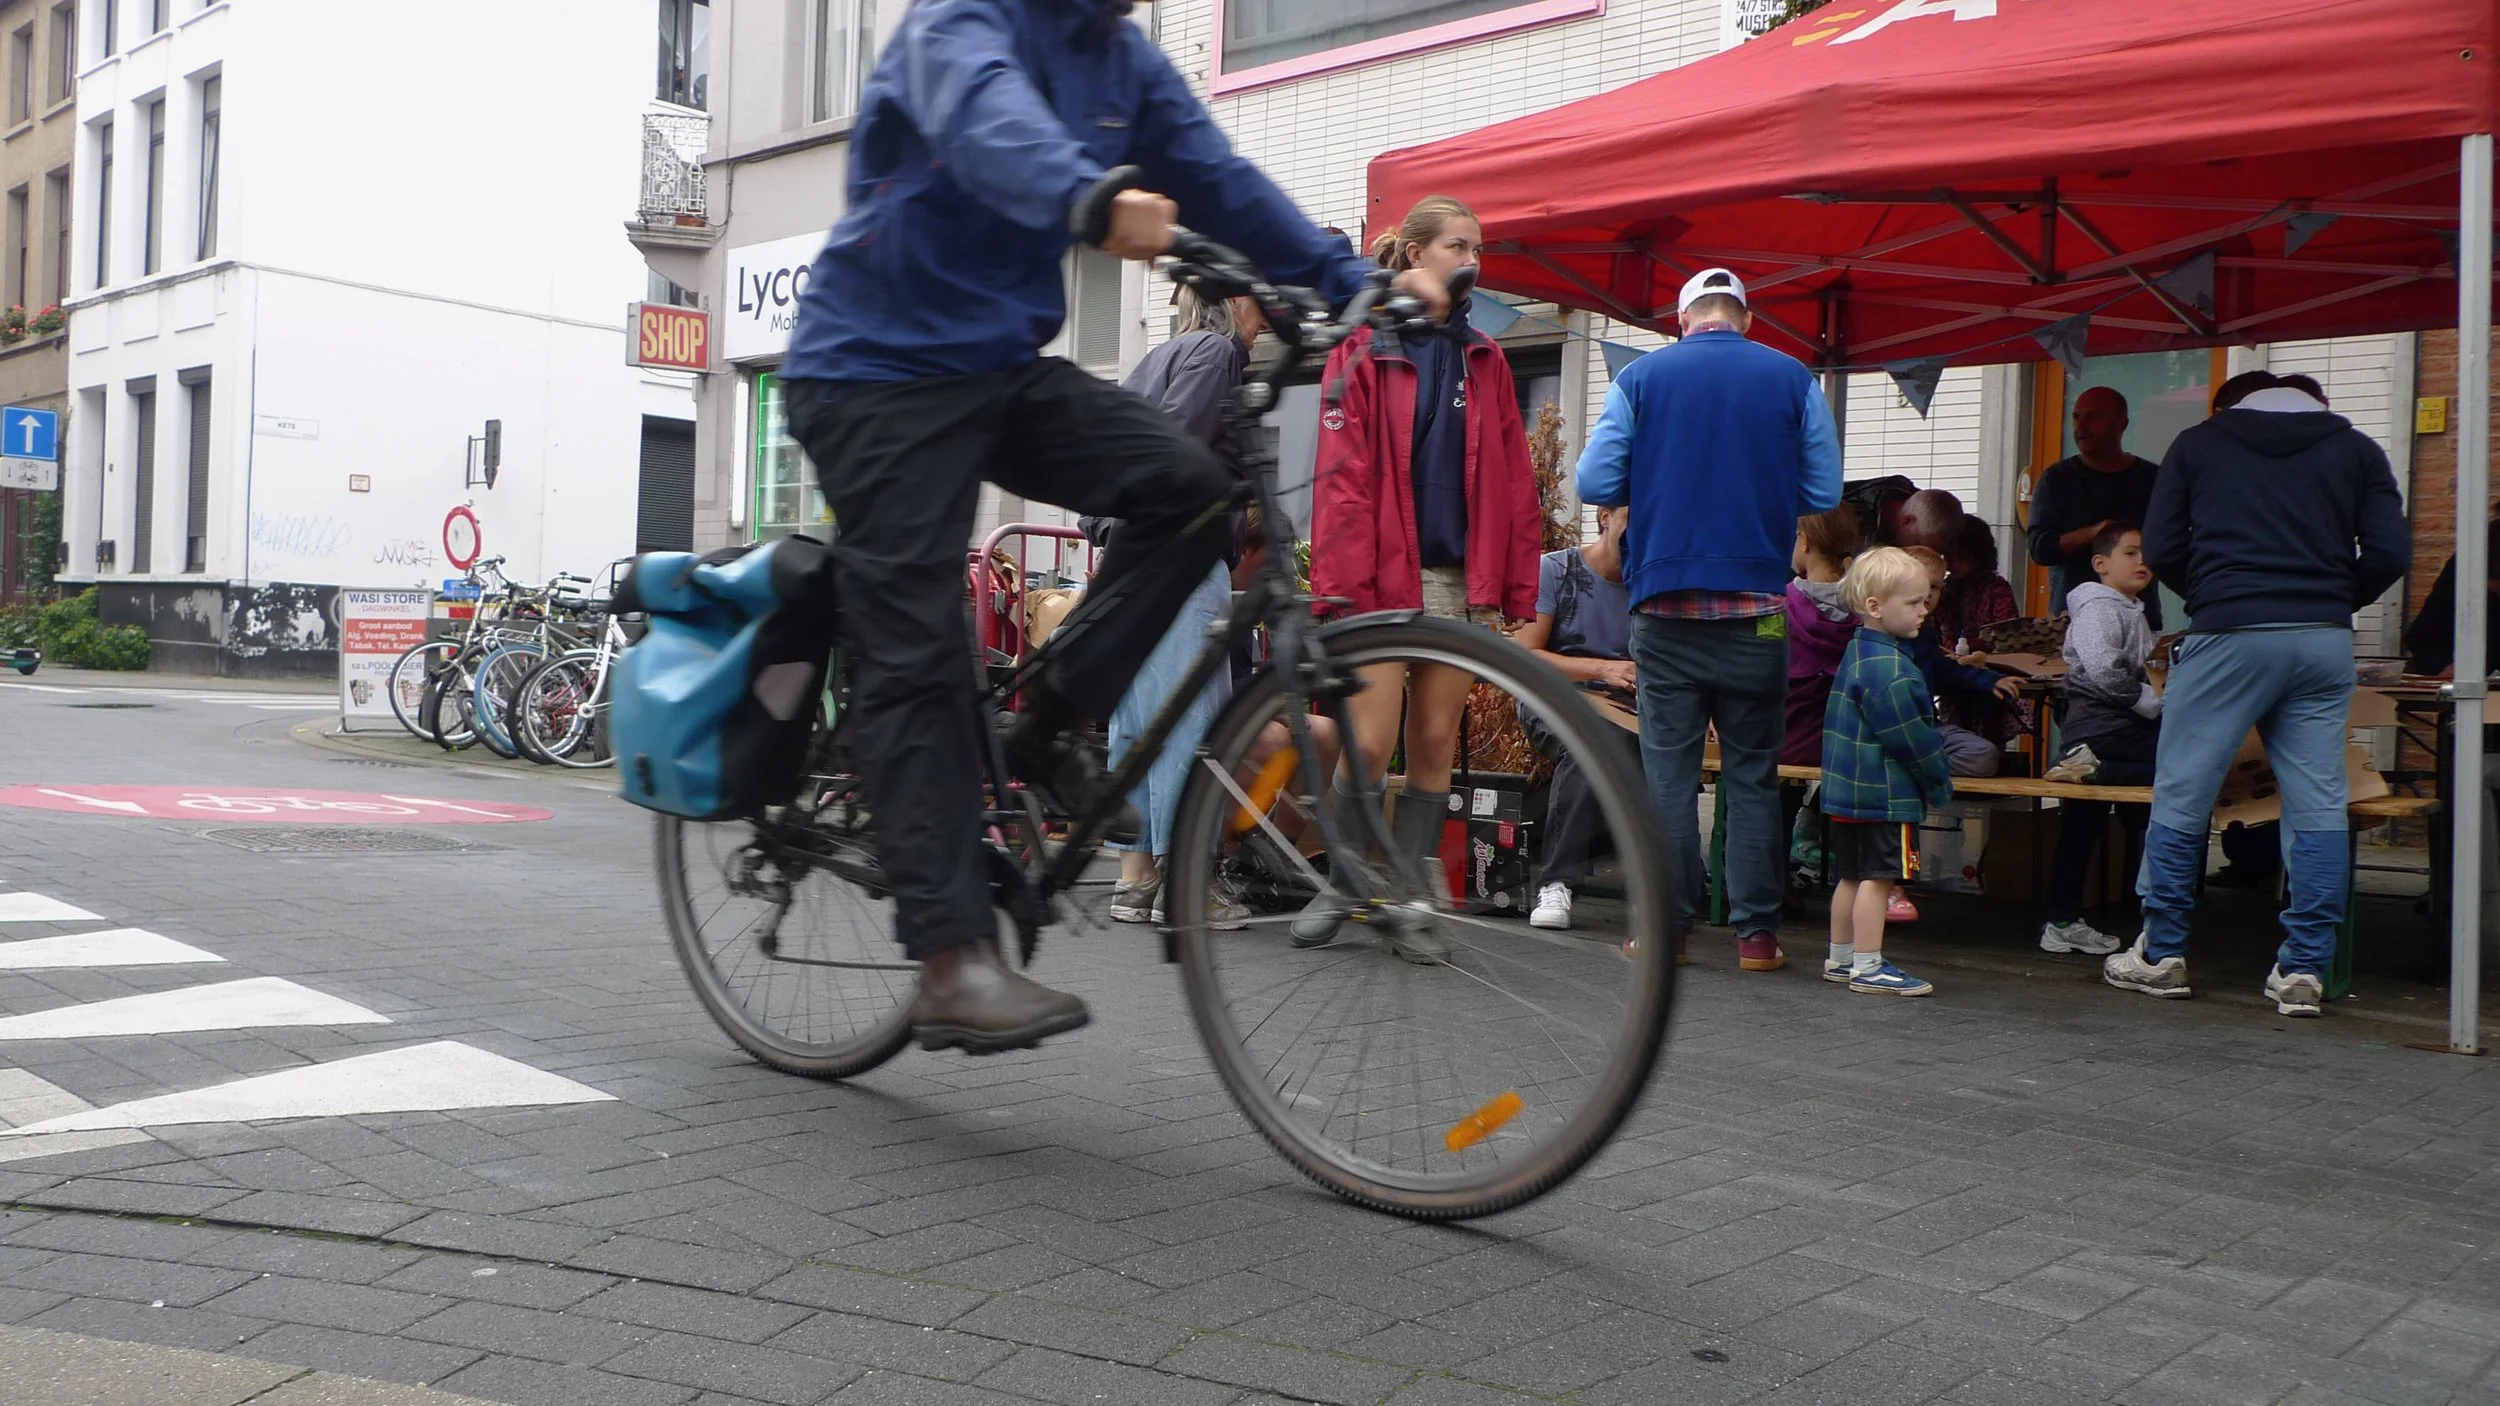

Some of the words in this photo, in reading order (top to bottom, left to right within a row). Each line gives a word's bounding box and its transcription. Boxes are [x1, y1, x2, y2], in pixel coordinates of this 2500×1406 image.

[738, 264, 812, 320] Lyco
[770, 311, 800, 332] Mob
[641, 311, 704, 363] SHOP
[349, 594, 380, 604] WASI
[384, 594, 425, 604] STORE
[362, 605, 412, 613] DAGWINKEL
[358, 621, 381, 630] Groot
[382, 622, 413, 630] aanbod
